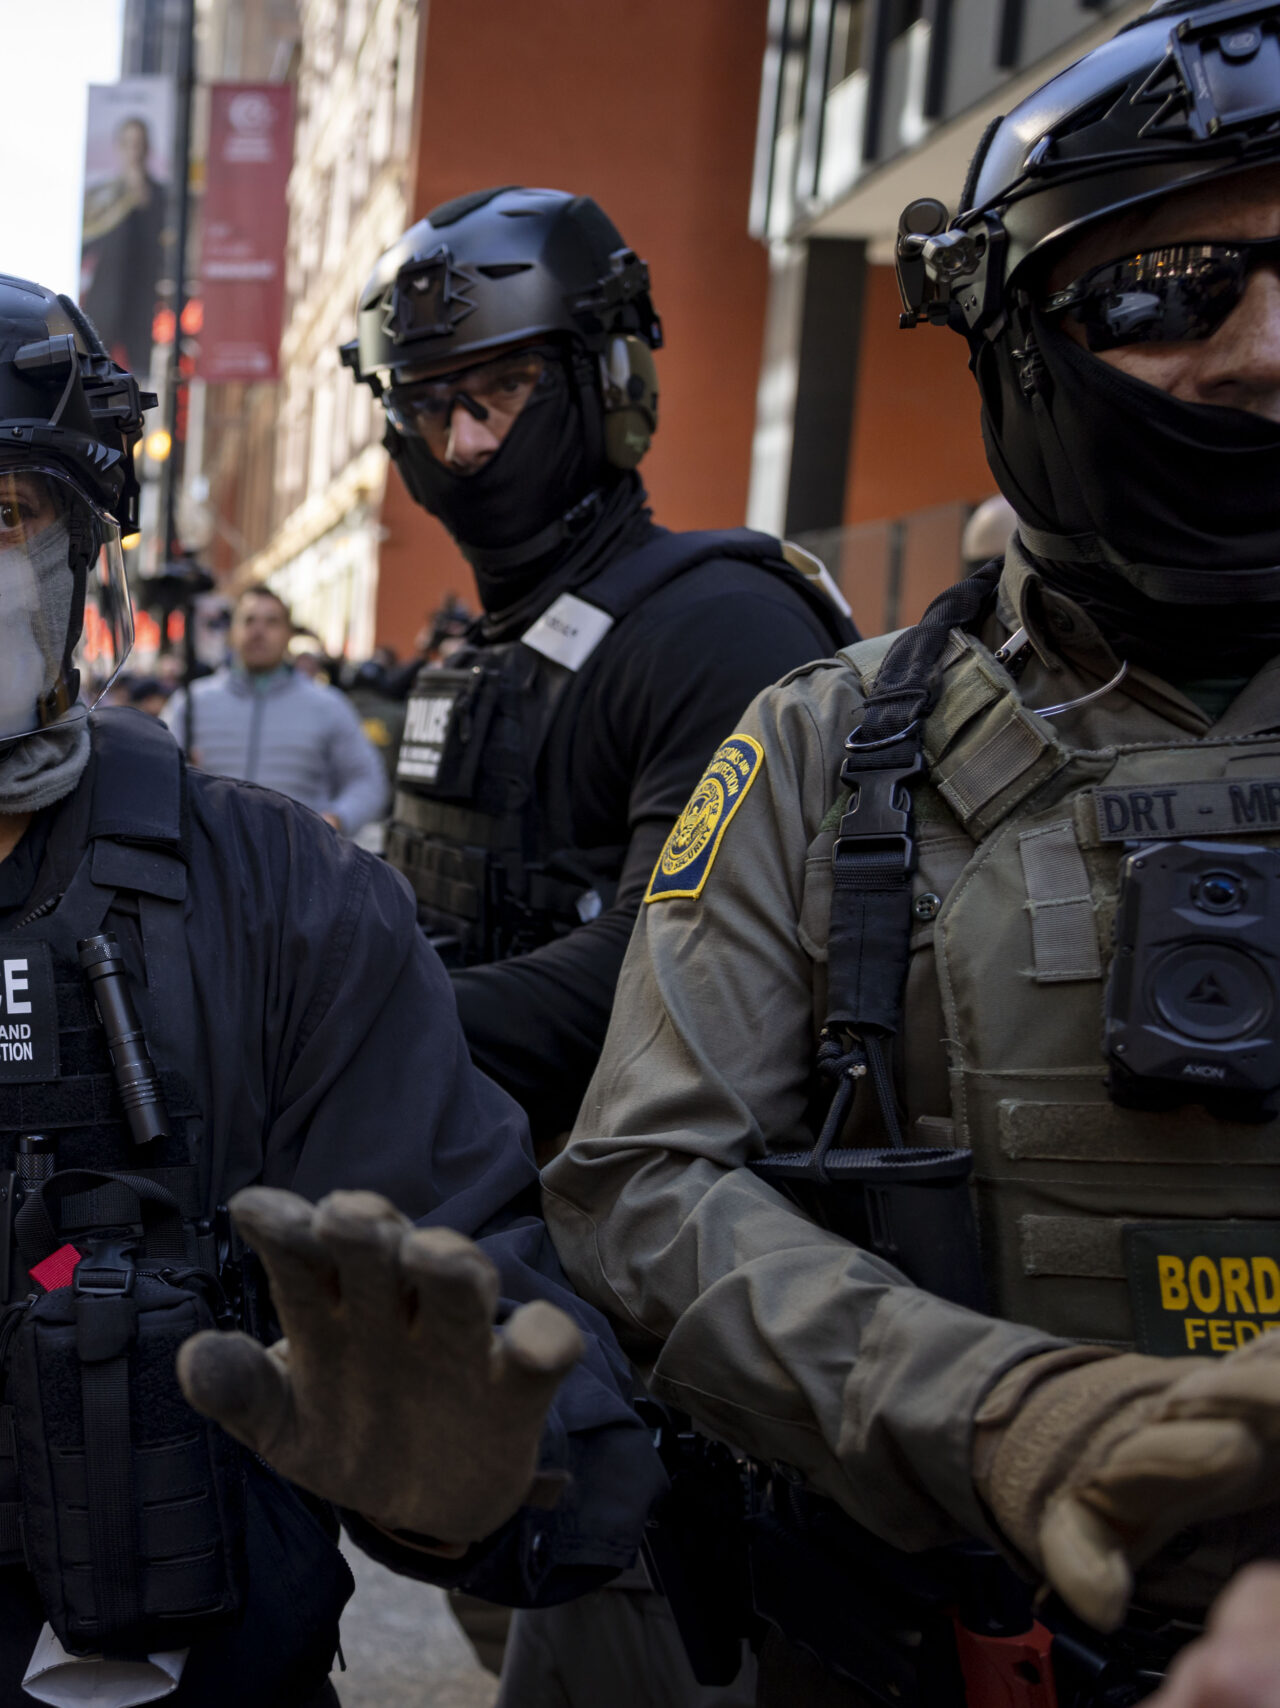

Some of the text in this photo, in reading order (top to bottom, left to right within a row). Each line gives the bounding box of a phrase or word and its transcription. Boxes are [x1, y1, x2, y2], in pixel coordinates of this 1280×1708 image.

[1102, 790, 1178, 834] DRT
[1157, 1255, 1280, 1315] BORD
[1184, 1317, 1280, 1351] FED
